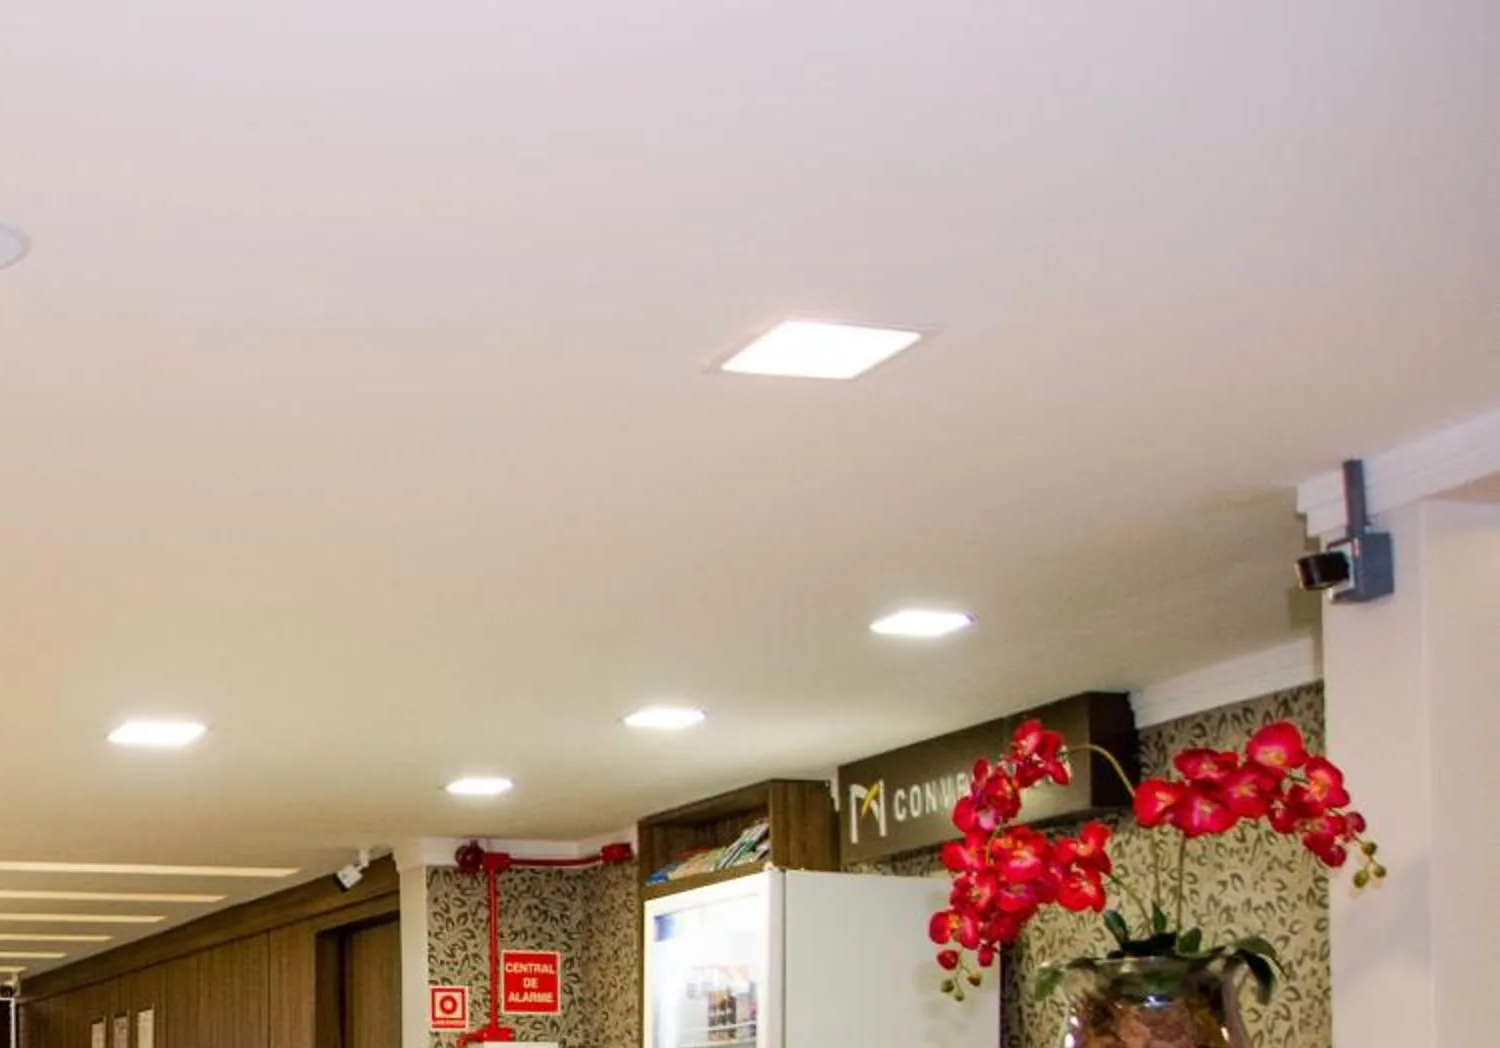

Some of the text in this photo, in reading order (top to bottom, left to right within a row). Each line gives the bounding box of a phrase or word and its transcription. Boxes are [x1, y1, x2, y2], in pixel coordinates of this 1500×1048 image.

[505, 962, 556, 975] CENTRAL
[523, 977, 539, 989] DE
[508, 991, 555, 1003] ALARME
